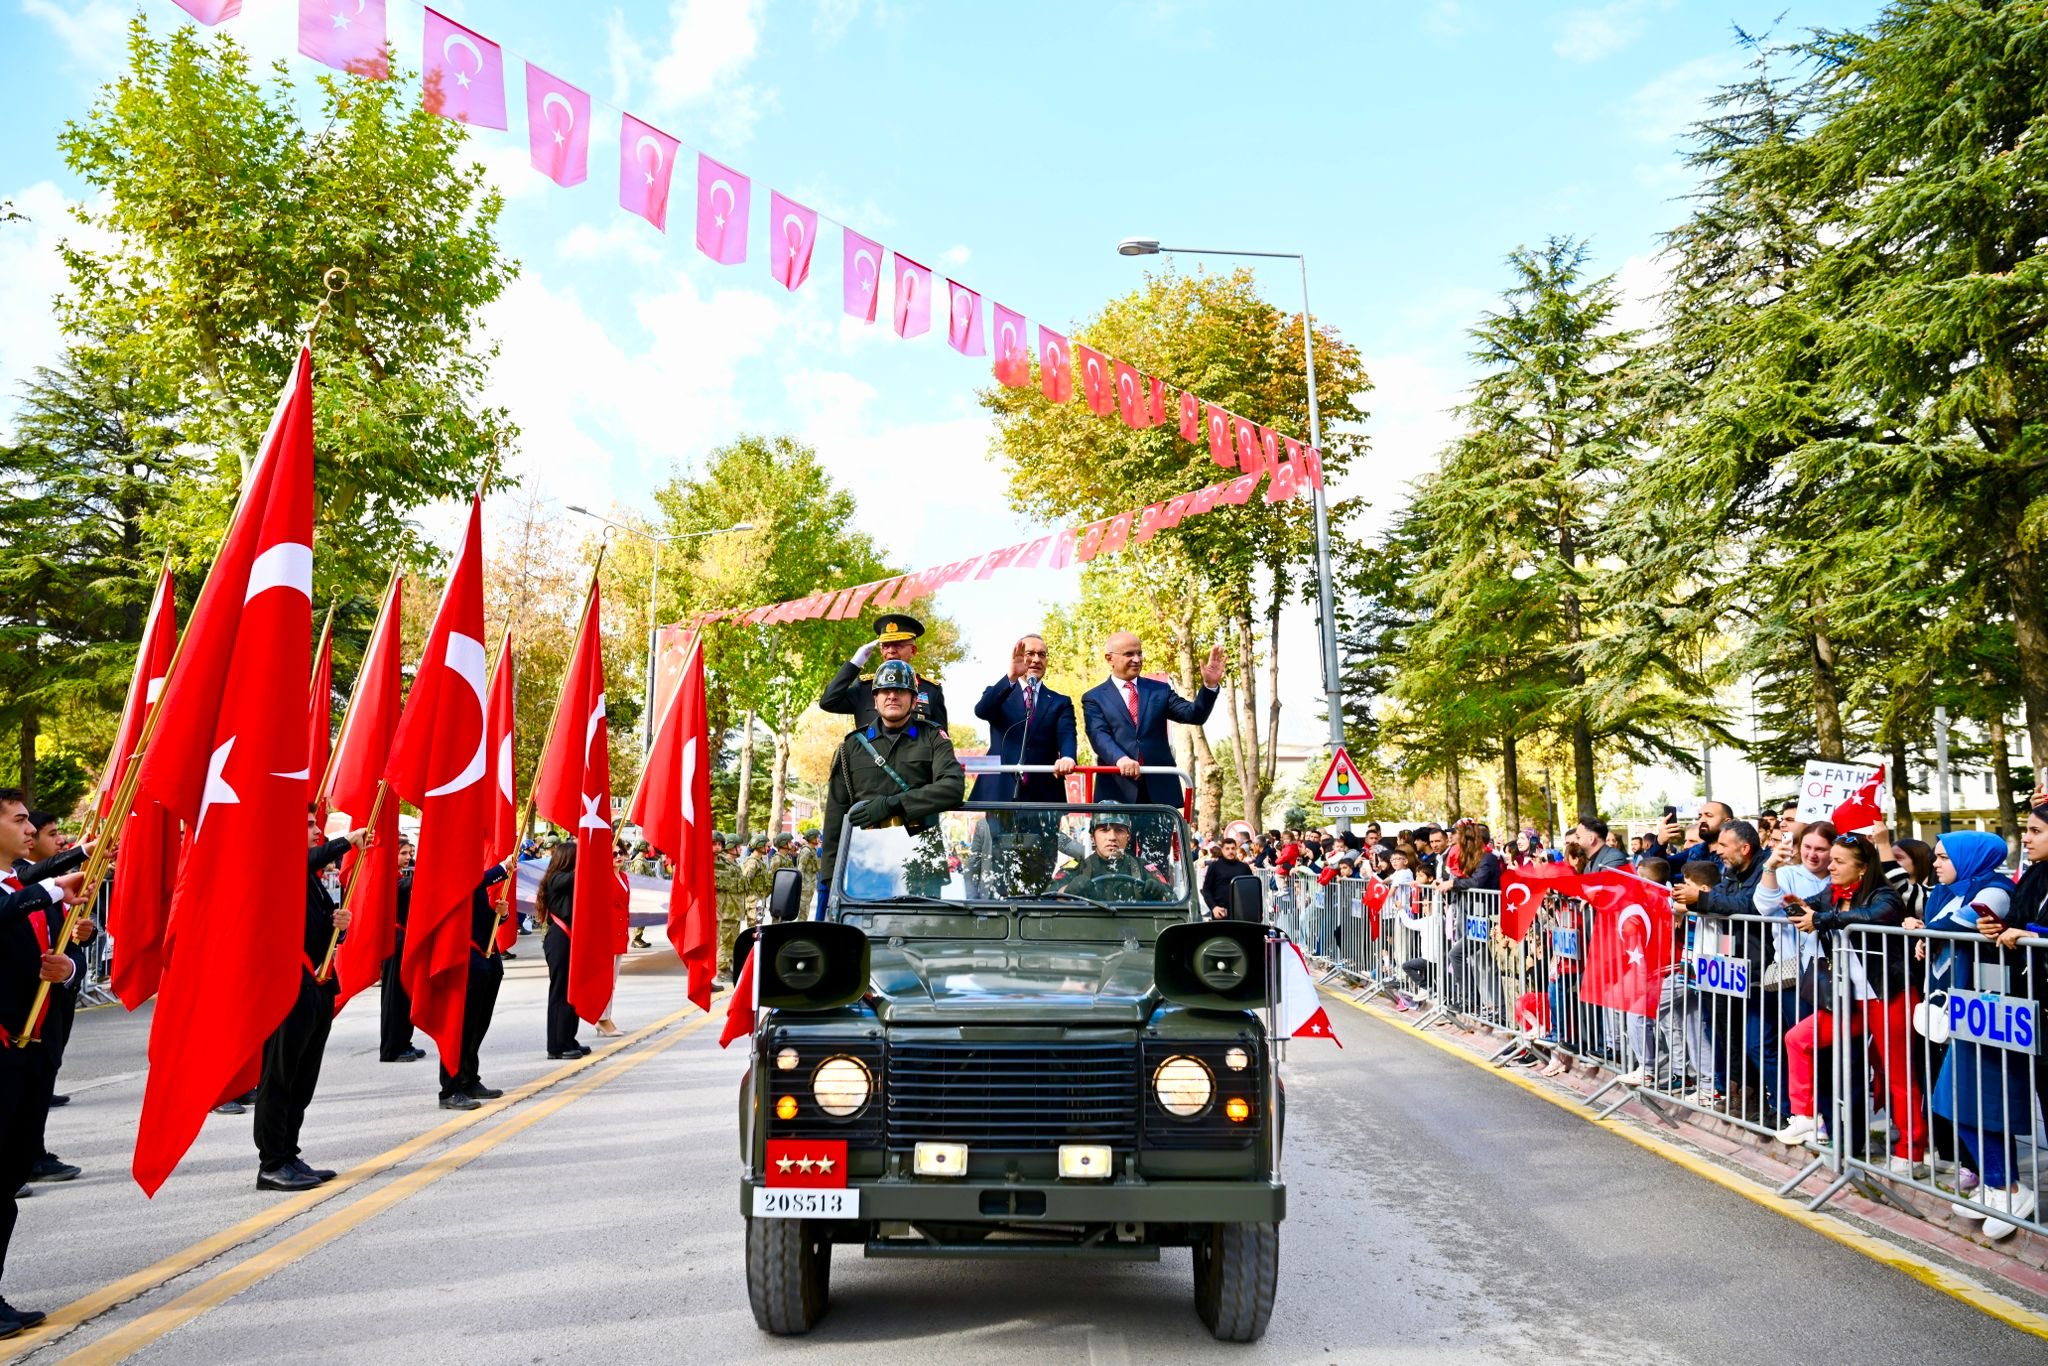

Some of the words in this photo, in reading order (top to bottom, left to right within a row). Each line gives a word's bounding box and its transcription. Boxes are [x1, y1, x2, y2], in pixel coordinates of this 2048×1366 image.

[1808, 782, 1833, 798] OF
[1328, 805, 1347, 814] 100
[765, 1193, 842, 1213] 208513
